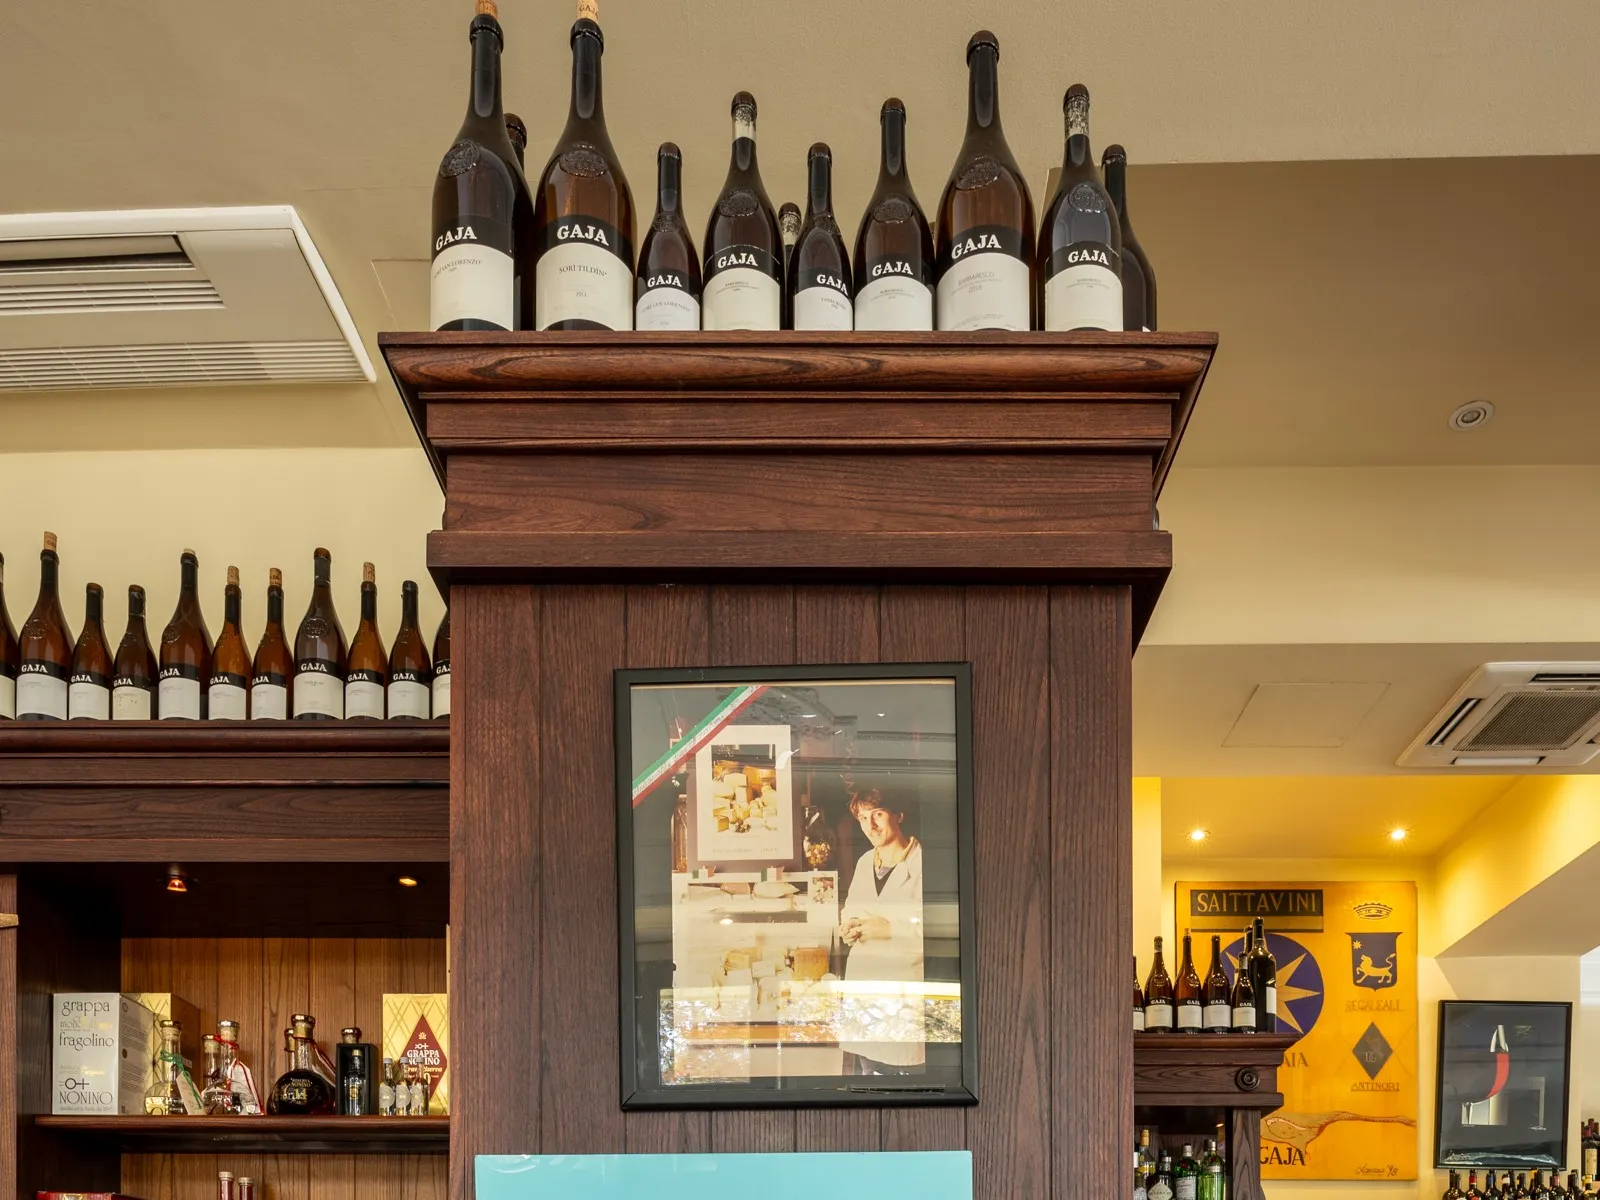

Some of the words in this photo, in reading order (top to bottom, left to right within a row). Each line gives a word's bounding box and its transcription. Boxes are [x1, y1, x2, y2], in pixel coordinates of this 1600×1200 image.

[435, 226, 477, 251] GAJA
[557, 224, 609, 246] GAJA
[951, 234, 1002, 259] GAJA
[717, 252, 758, 269] GAJA
[1068, 249, 1109, 265] GAJA
[872, 261, 913, 276] GAJA
[647, 274, 682, 288] GAJA
[817, 274, 848, 296] GAJA
[21, 664, 48, 673] GAJA
[301, 663, 328, 672] GAJA
[436, 664, 450, 674] GAJ
[71, 674, 93, 683] GAJA
[159, 668, 181, 679] GAJA
[348, 673, 369, 682] GAJA
[393, 673, 416, 681] GAJA
[113, 678, 133, 686] GAJA
[210, 676, 230, 685] GAJA
[252, 676, 270, 686] GAJA
[62, 1001, 110, 1016] grappa
[59, 1032, 114, 1051] fragolino
[407, 1049, 440, 1058] GRAPPA
[408, 1057, 440, 1066] NOINO
[1351, 1082, 1400, 1092] ANTINORI
[59, 1091, 113, 1105] NONINO
[1260, 1146, 1307, 1166] GAJA
